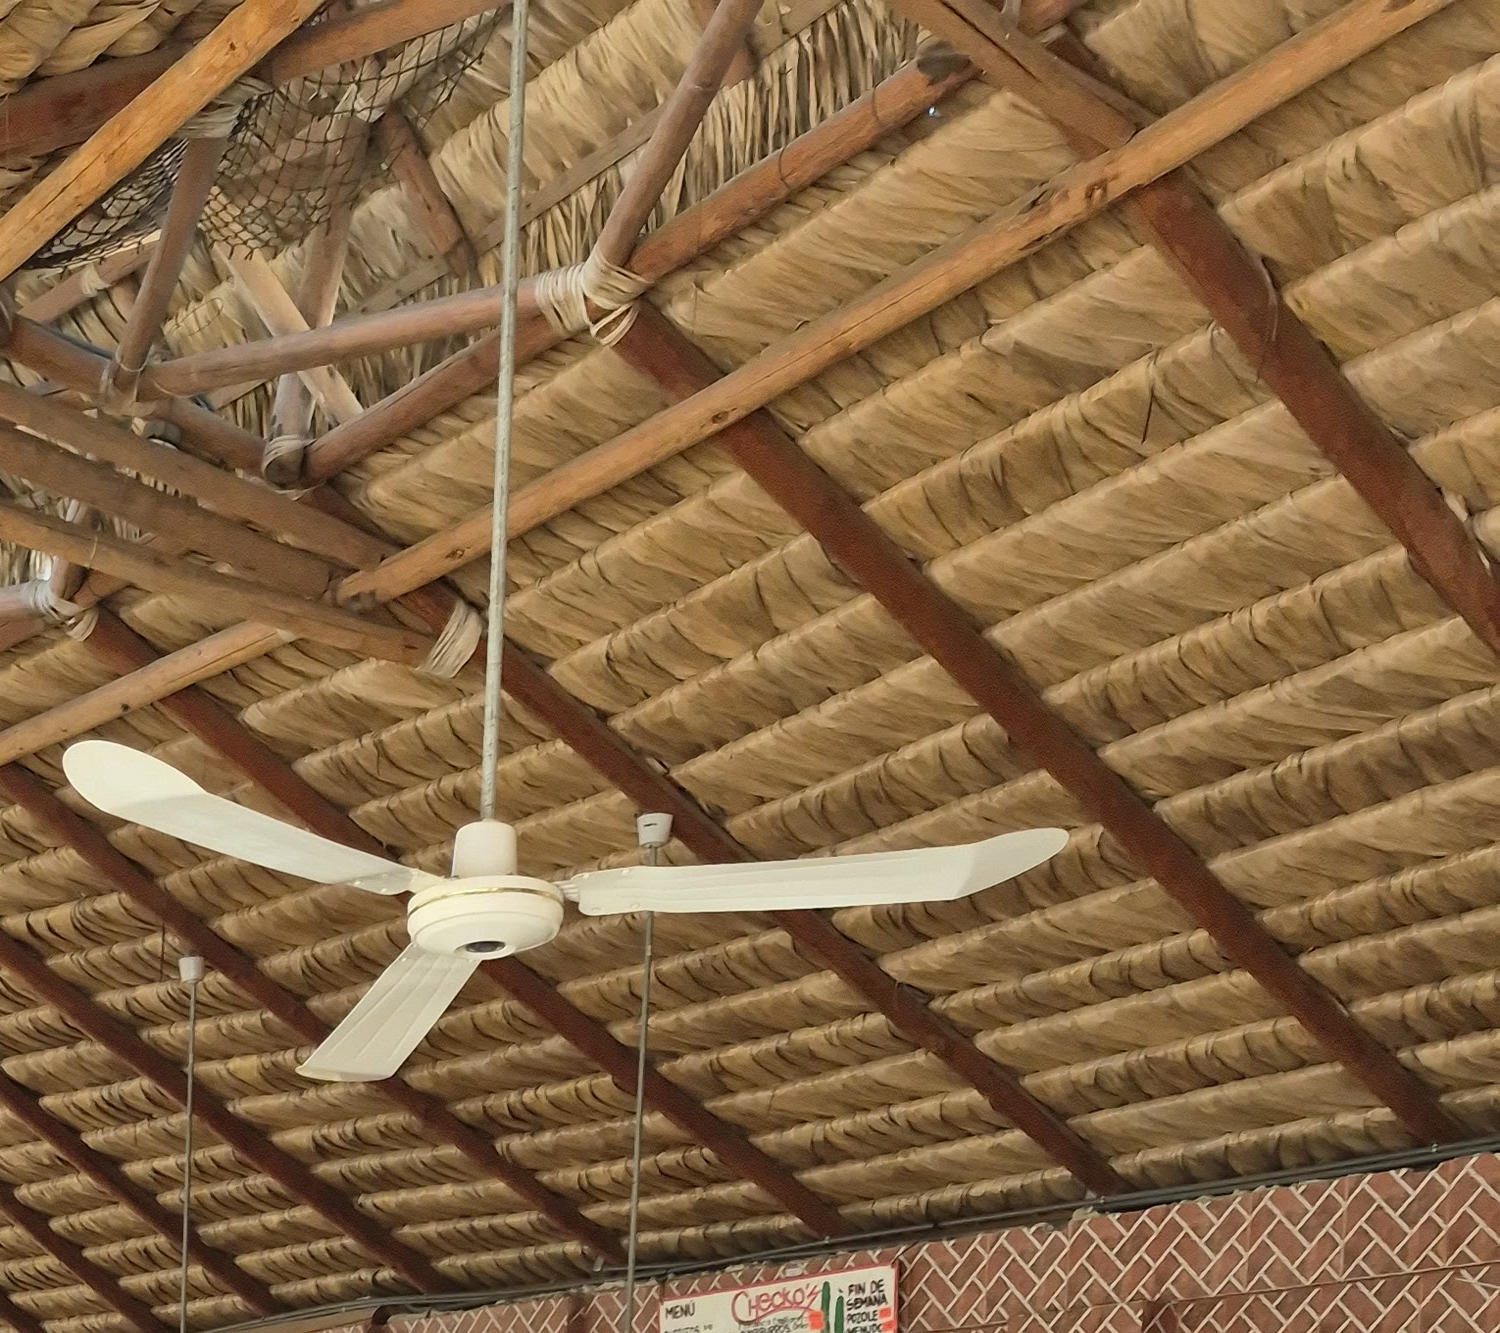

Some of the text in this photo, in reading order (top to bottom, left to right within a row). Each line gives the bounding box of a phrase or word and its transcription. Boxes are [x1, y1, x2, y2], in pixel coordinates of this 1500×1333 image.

[848, 1278, 885, 1296] FIN DE
[846, 1293, 888, 1311] SEMANA
[846, 1310, 879, 1325] POZOLE
